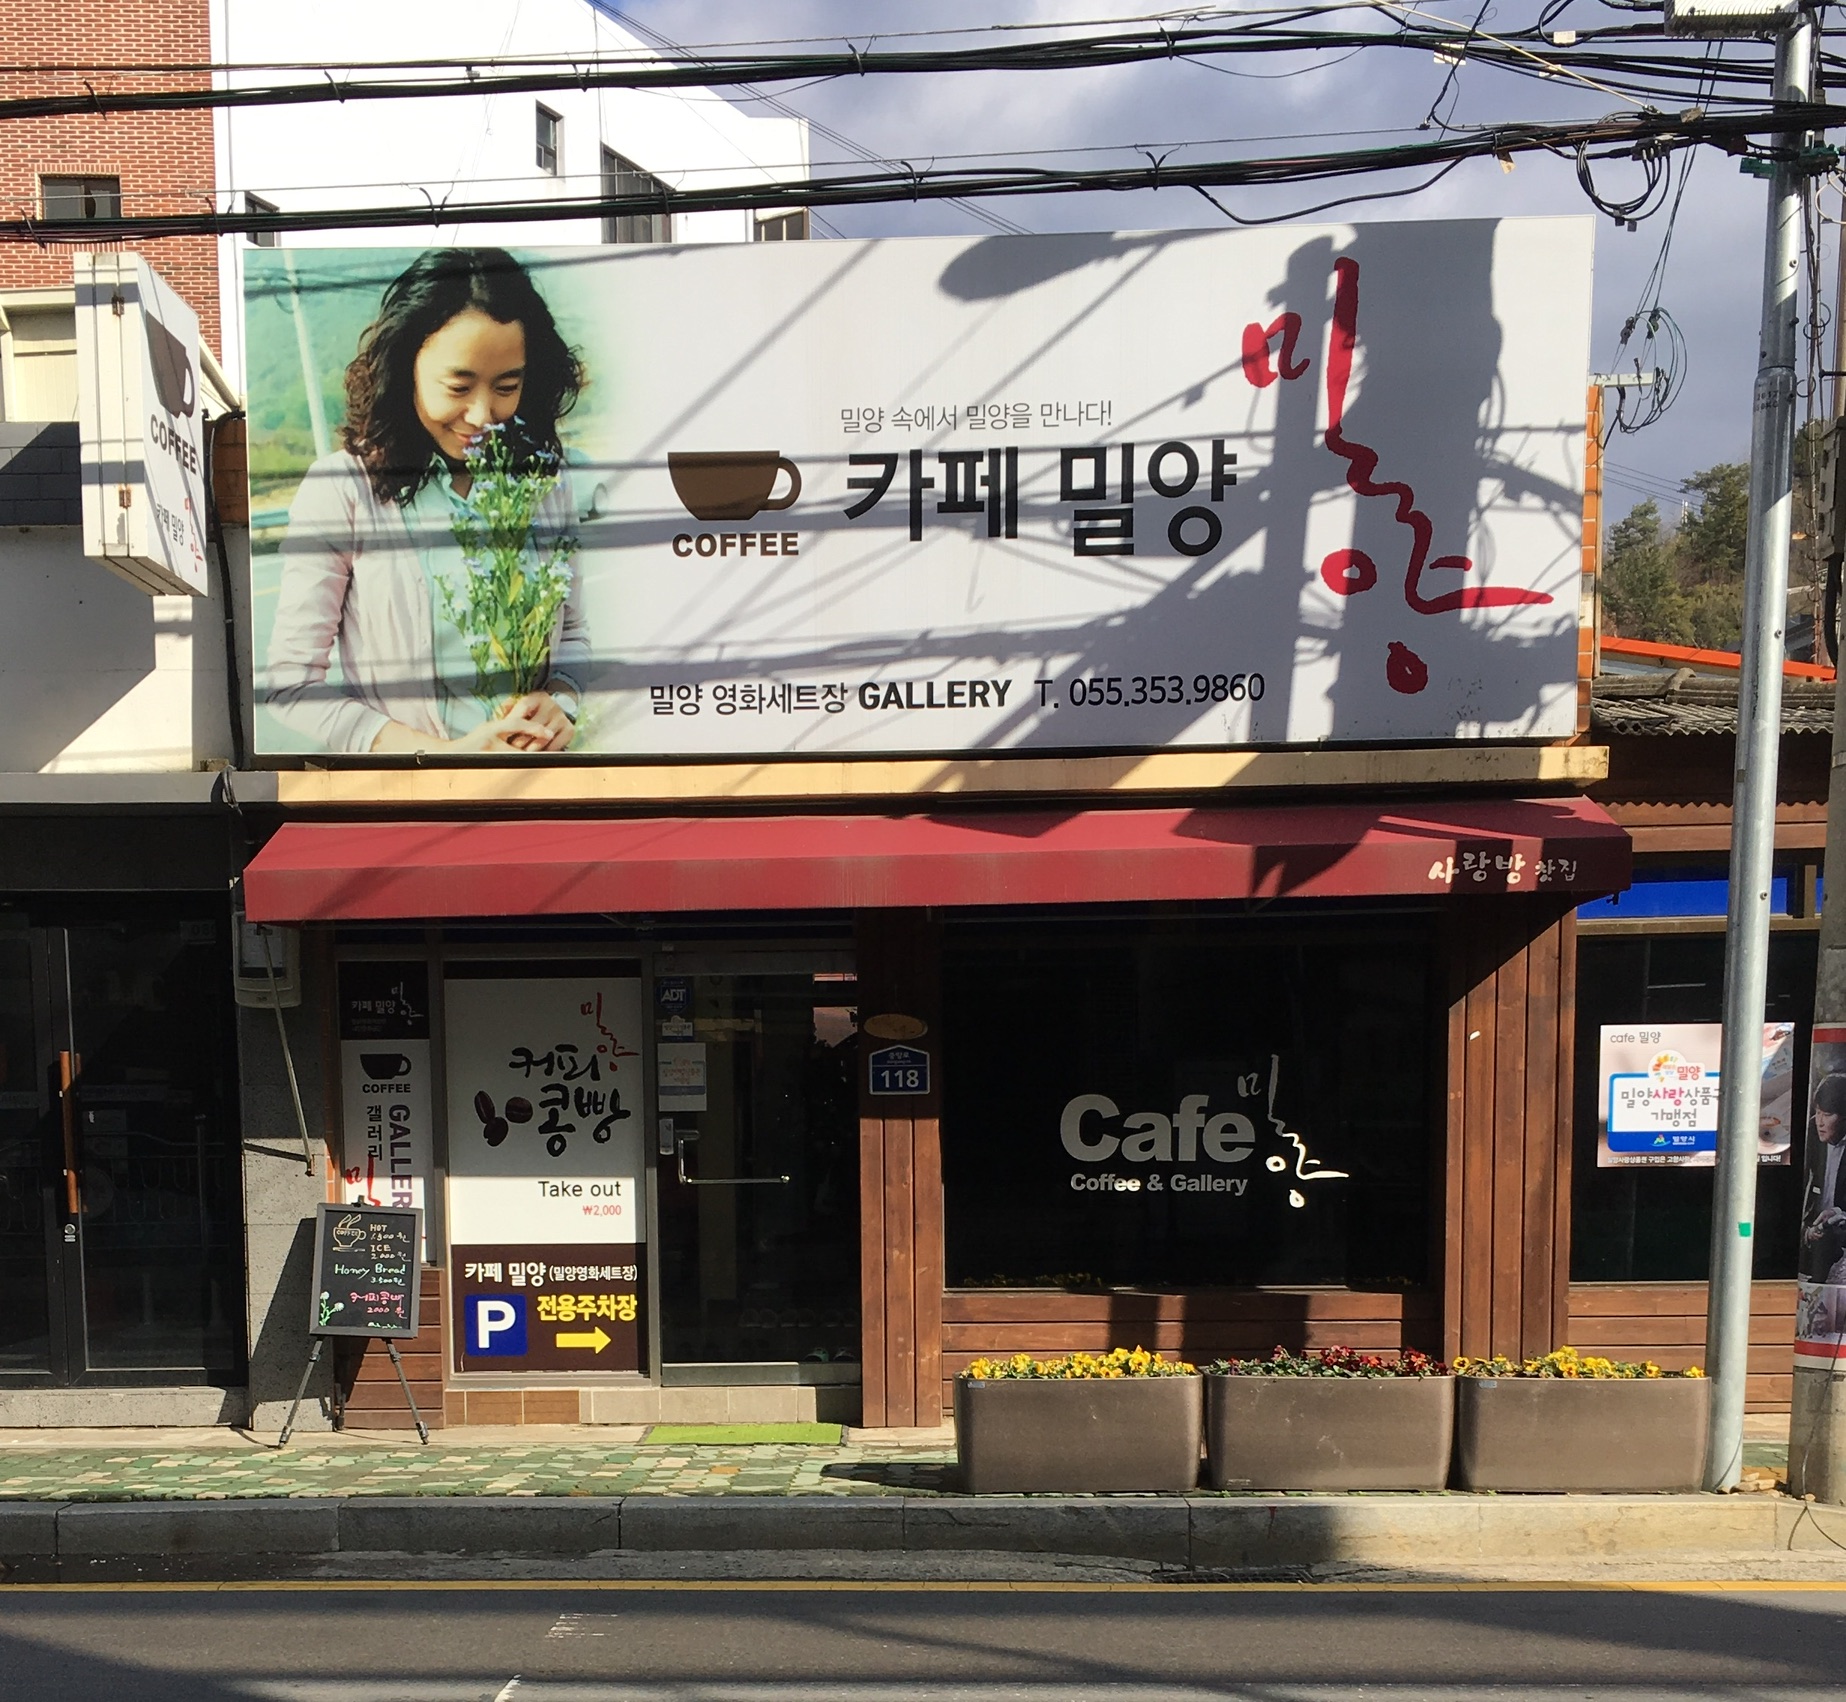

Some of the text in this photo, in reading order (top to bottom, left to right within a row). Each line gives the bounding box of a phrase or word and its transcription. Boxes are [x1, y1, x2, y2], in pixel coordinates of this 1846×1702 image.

[840, 400, 1113, 433] 밀양 속에서 밀양을 만나다!
[150, 413, 197, 475] COFFEE
[843, 439, 1238, 557] 카페 밀양
[156, 502, 184, 546] 카페 밀양
[672, 532, 799, 557] COFFEE
[649, 673, 1266, 716] 밀양 영화세트장 GALLERY T. 055.353.9860
[1428, 851, 1526, 884] 사랑방
[351, 1000, 396, 1015] 카페 밀양
[661, 988, 687, 1002] ADT
[1610, 1031, 1661, 1044] cafe 밀양
[509, 1043, 601, 1081] 커피
[1676, 1065, 1701, 1081] 밀양
[362, 1083, 411, 1093] COFFEE
[880, 1069, 919, 1088] 118
[537, 1083, 631, 1157] 콩빵
[1060, 1093, 1256, 1163] Cafe
[1651, 1108, 1697, 1127] 가맹점
[366, 1104, 383, 1161] 갤러리
[538, 1180, 622, 1197] Take out
[1070, 1173, 1248, 1196] Coffee & Gallery
[370, 1224, 388, 1232] HOT
[370, 1244, 391, 1252] ICE
[335, 1263, 406, 1280] Honey Bread
[464, 1262, 638, 1287] 카페 밀양 (밀양영화세트장)
[536, 1294, 638, 1322] 전용주차장
[477, 1300, 516, 1349] P
